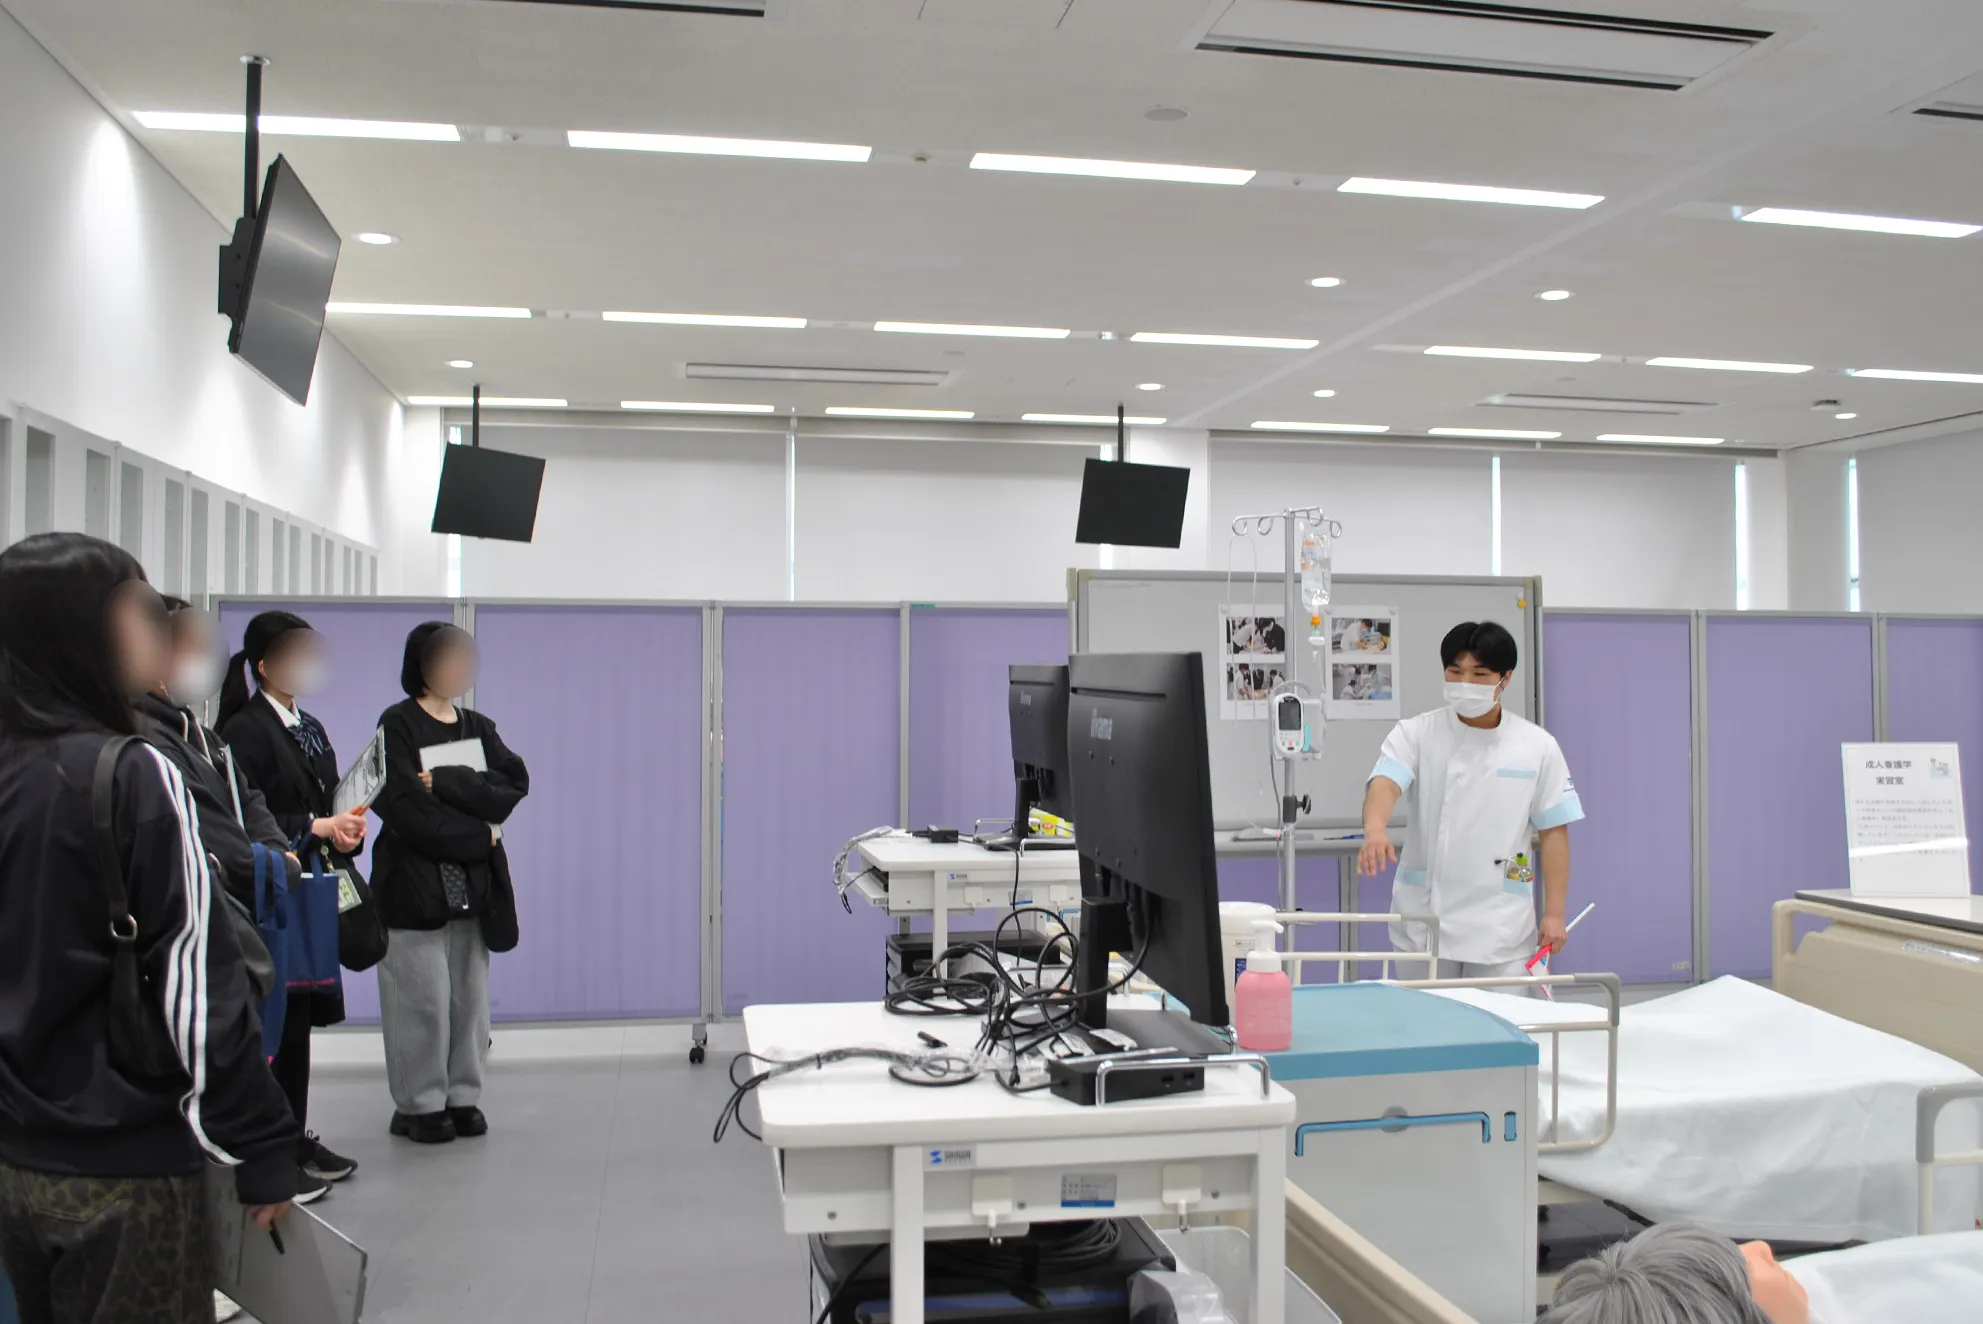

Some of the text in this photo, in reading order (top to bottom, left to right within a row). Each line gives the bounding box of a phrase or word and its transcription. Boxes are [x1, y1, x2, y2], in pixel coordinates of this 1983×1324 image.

[1865, 760, 1911, 769] 成人看護学
[1876, 776, 1904, 785] 実習室
